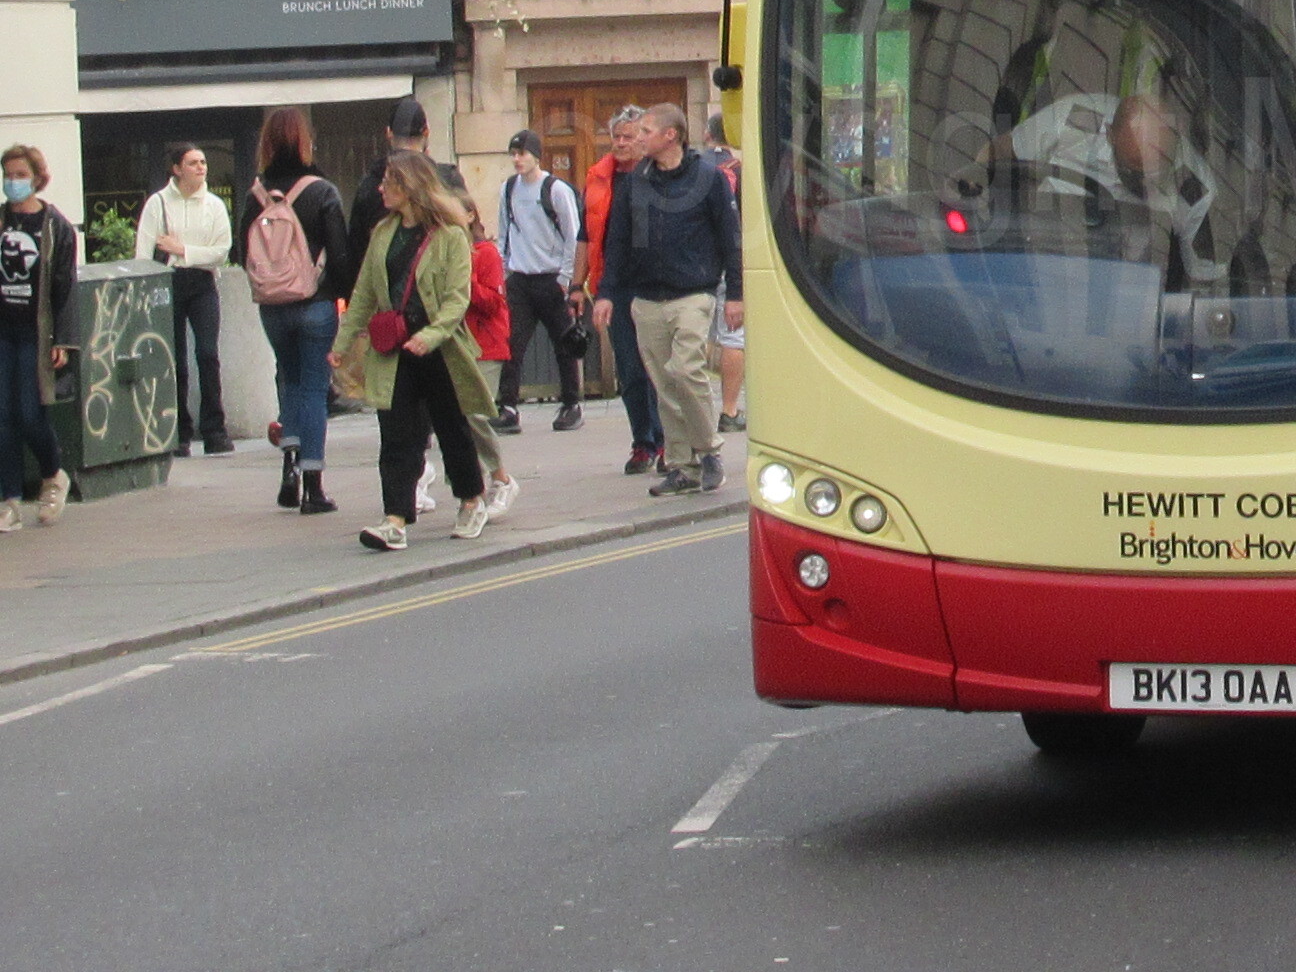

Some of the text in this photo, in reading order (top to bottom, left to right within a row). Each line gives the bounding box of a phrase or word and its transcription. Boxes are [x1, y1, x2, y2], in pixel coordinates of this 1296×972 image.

[282, 1, 332, 14] BRUNCH
[335, 0, 377, 11] LUNCH
[1102, 491, 1226, 519] HEWITT
[1132, 667, 1294, 705] BK13 OAA
